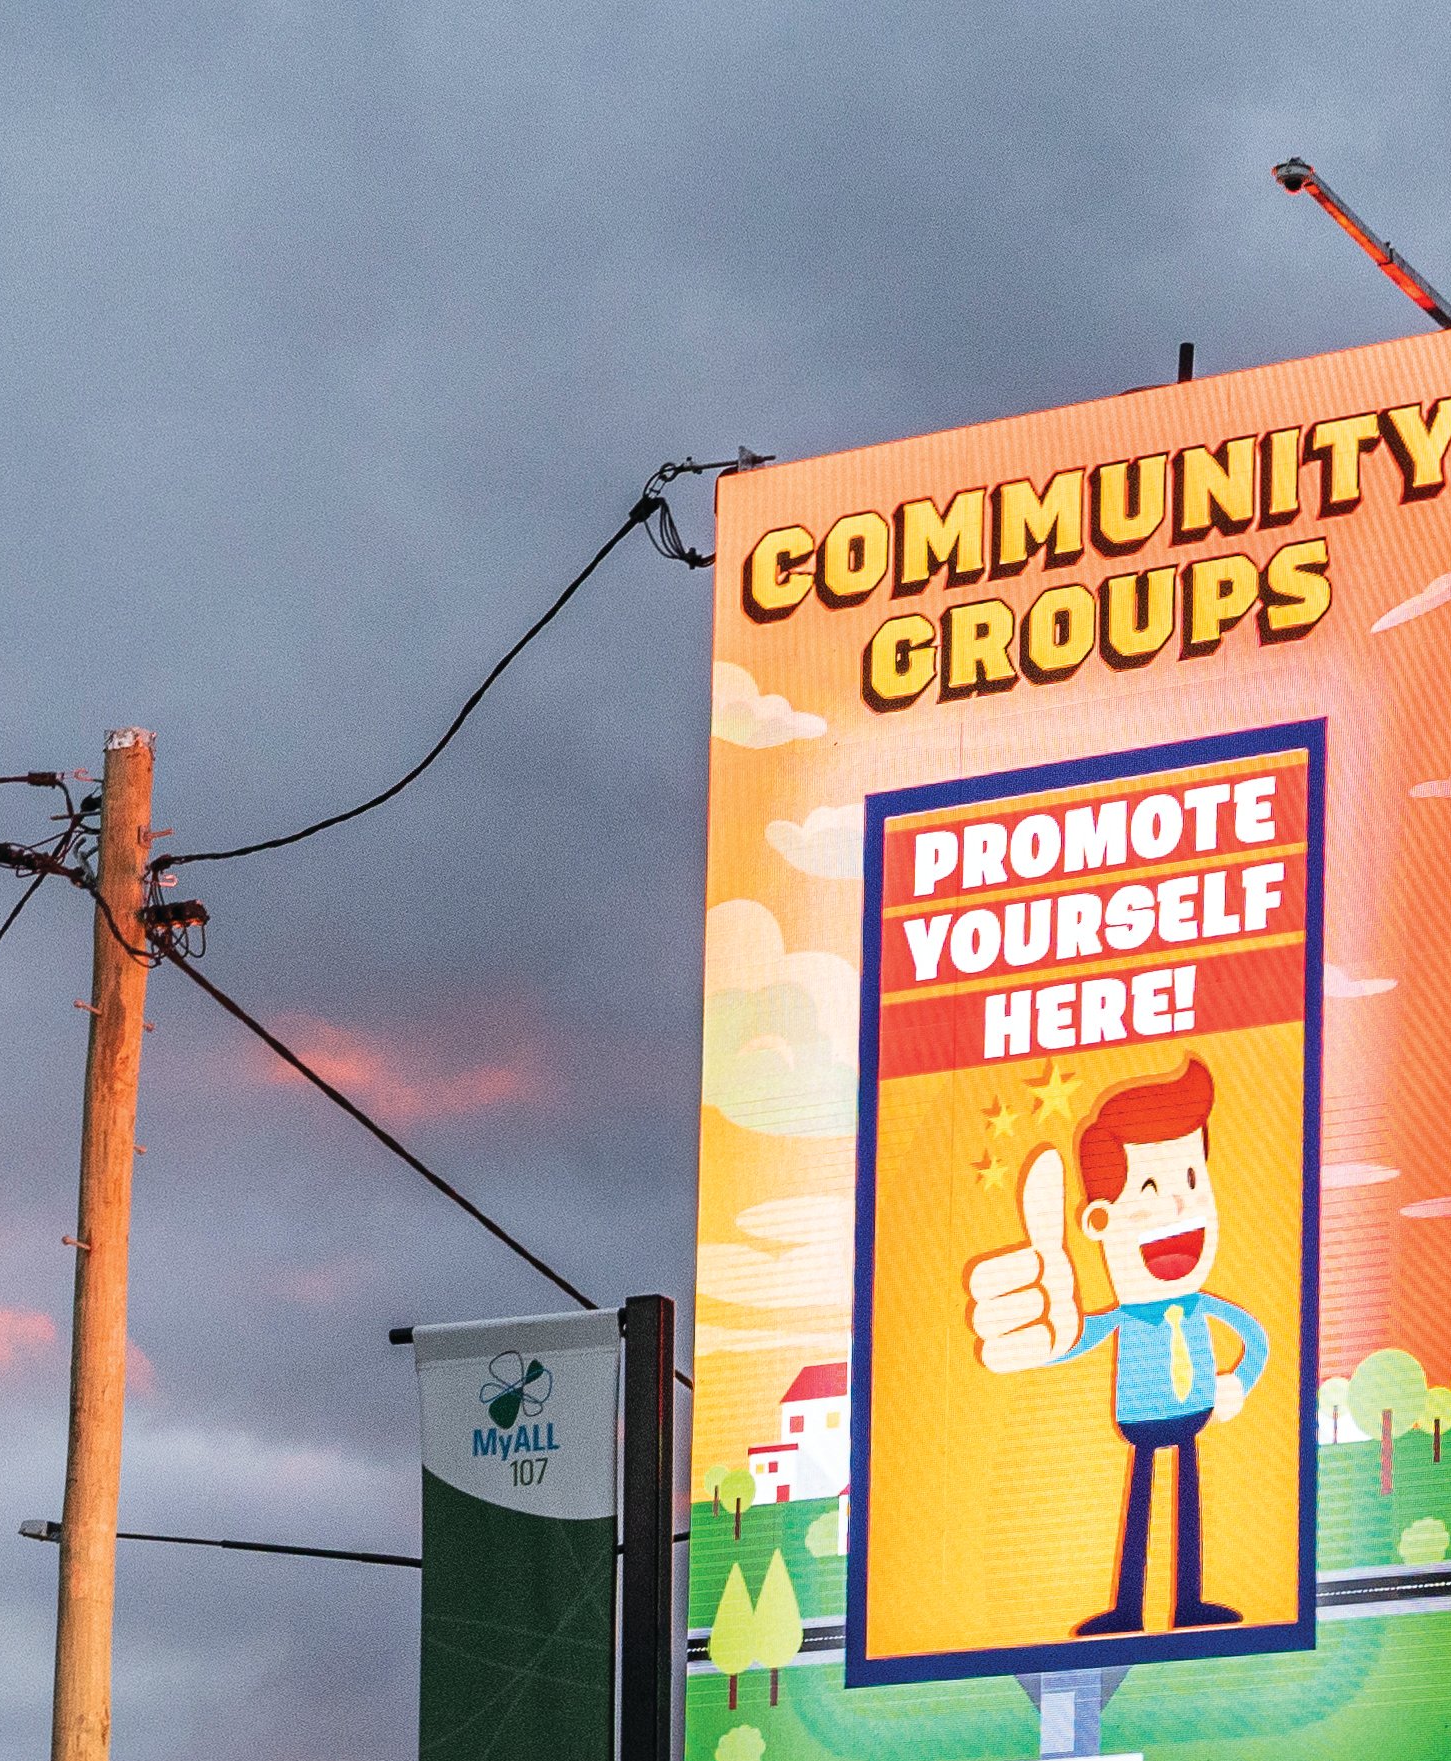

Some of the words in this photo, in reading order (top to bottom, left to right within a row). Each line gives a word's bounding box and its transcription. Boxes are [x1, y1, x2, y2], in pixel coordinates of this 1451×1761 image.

[861, 538, 1331, 713] GROUPS
[912, 778, 1277, 900] PROMOTE
[904, 863, 1285, 982] YOURSELF
[982, 965, 1197, 1060] HERE!
[472, 1423, 560, 1461] MyALL
[509, 1457, 548, 1487] 107
